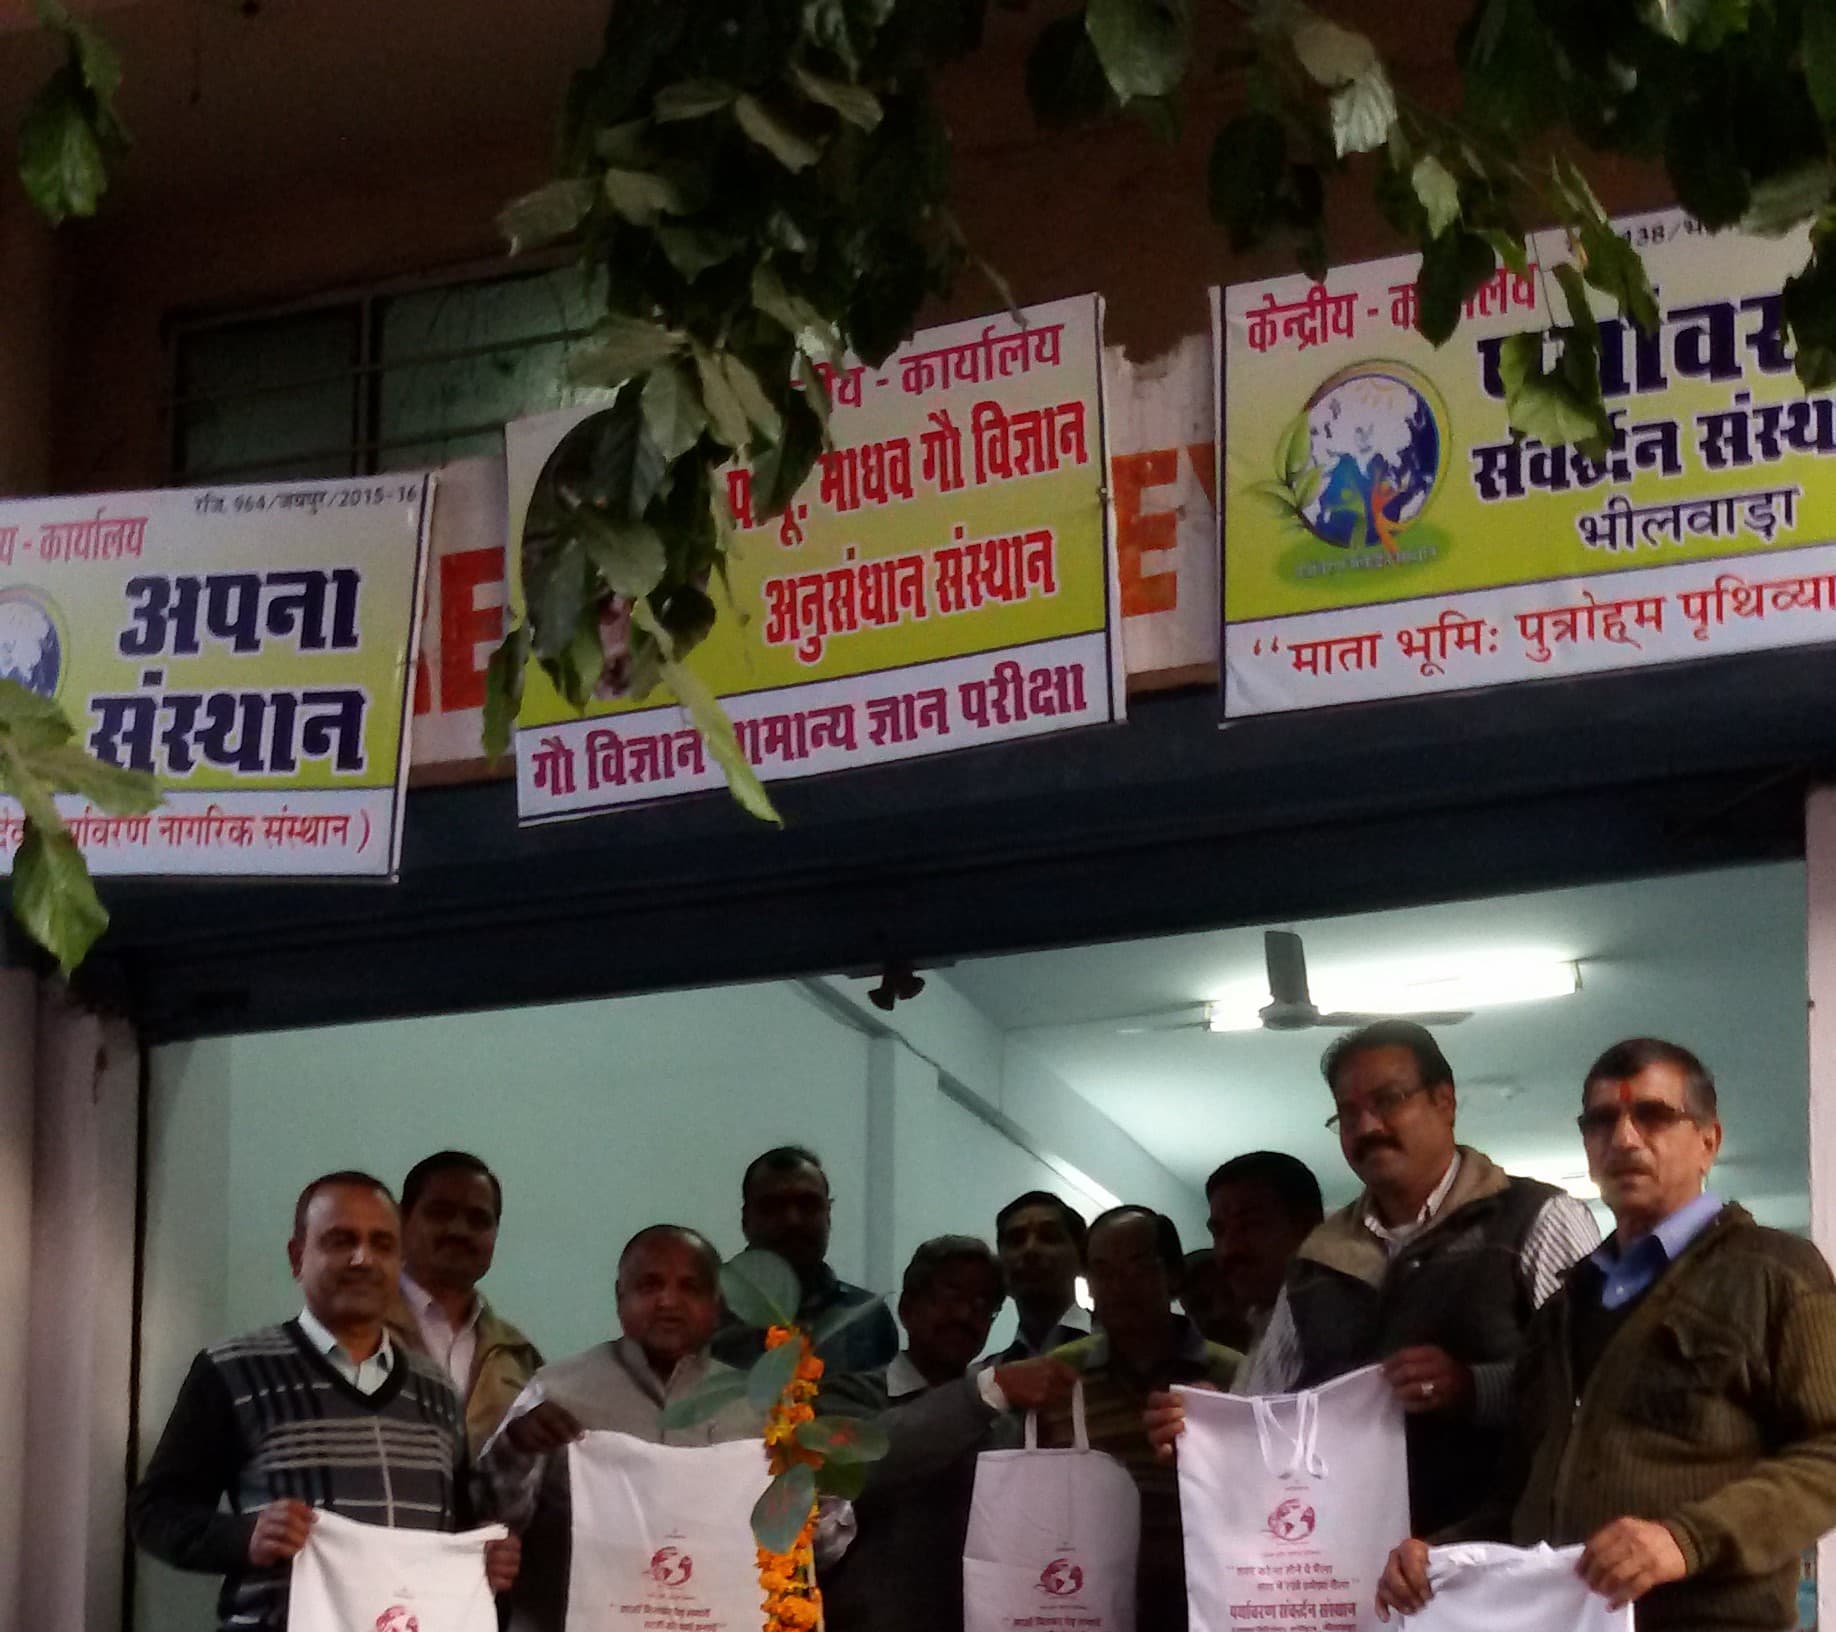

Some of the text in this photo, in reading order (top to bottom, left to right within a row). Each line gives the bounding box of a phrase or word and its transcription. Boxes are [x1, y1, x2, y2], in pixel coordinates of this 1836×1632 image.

[1246, 284, 1358, 352] केन्द्रीय
[900, 325, 1065, 395] कार्यालय
[818, 437, 914, 512] माधव
[920, 408, 965, 492] गौ
[971, 400, 1088, 485] विज्ञान
[40, 506, 149, 563] कार्यालय
[1578, 488, 1801, 549] भीलवाड़ा
[119, 568, 361, 656] अपना
[765, 526, 1057, 660] अनुसंधान संस्थान
[89, 670, 367, 776] संस्थान
[532, 735, 576, 797] गौ
[586, 729, 705, 790] विज्ञान
[866, 687, 950, 747] ज्ञान
[958, 659, 1088, 729] परीक्षा
[158, 803, 255, 848] नागरिक
[262, 804, 349, 849] संस्थान
